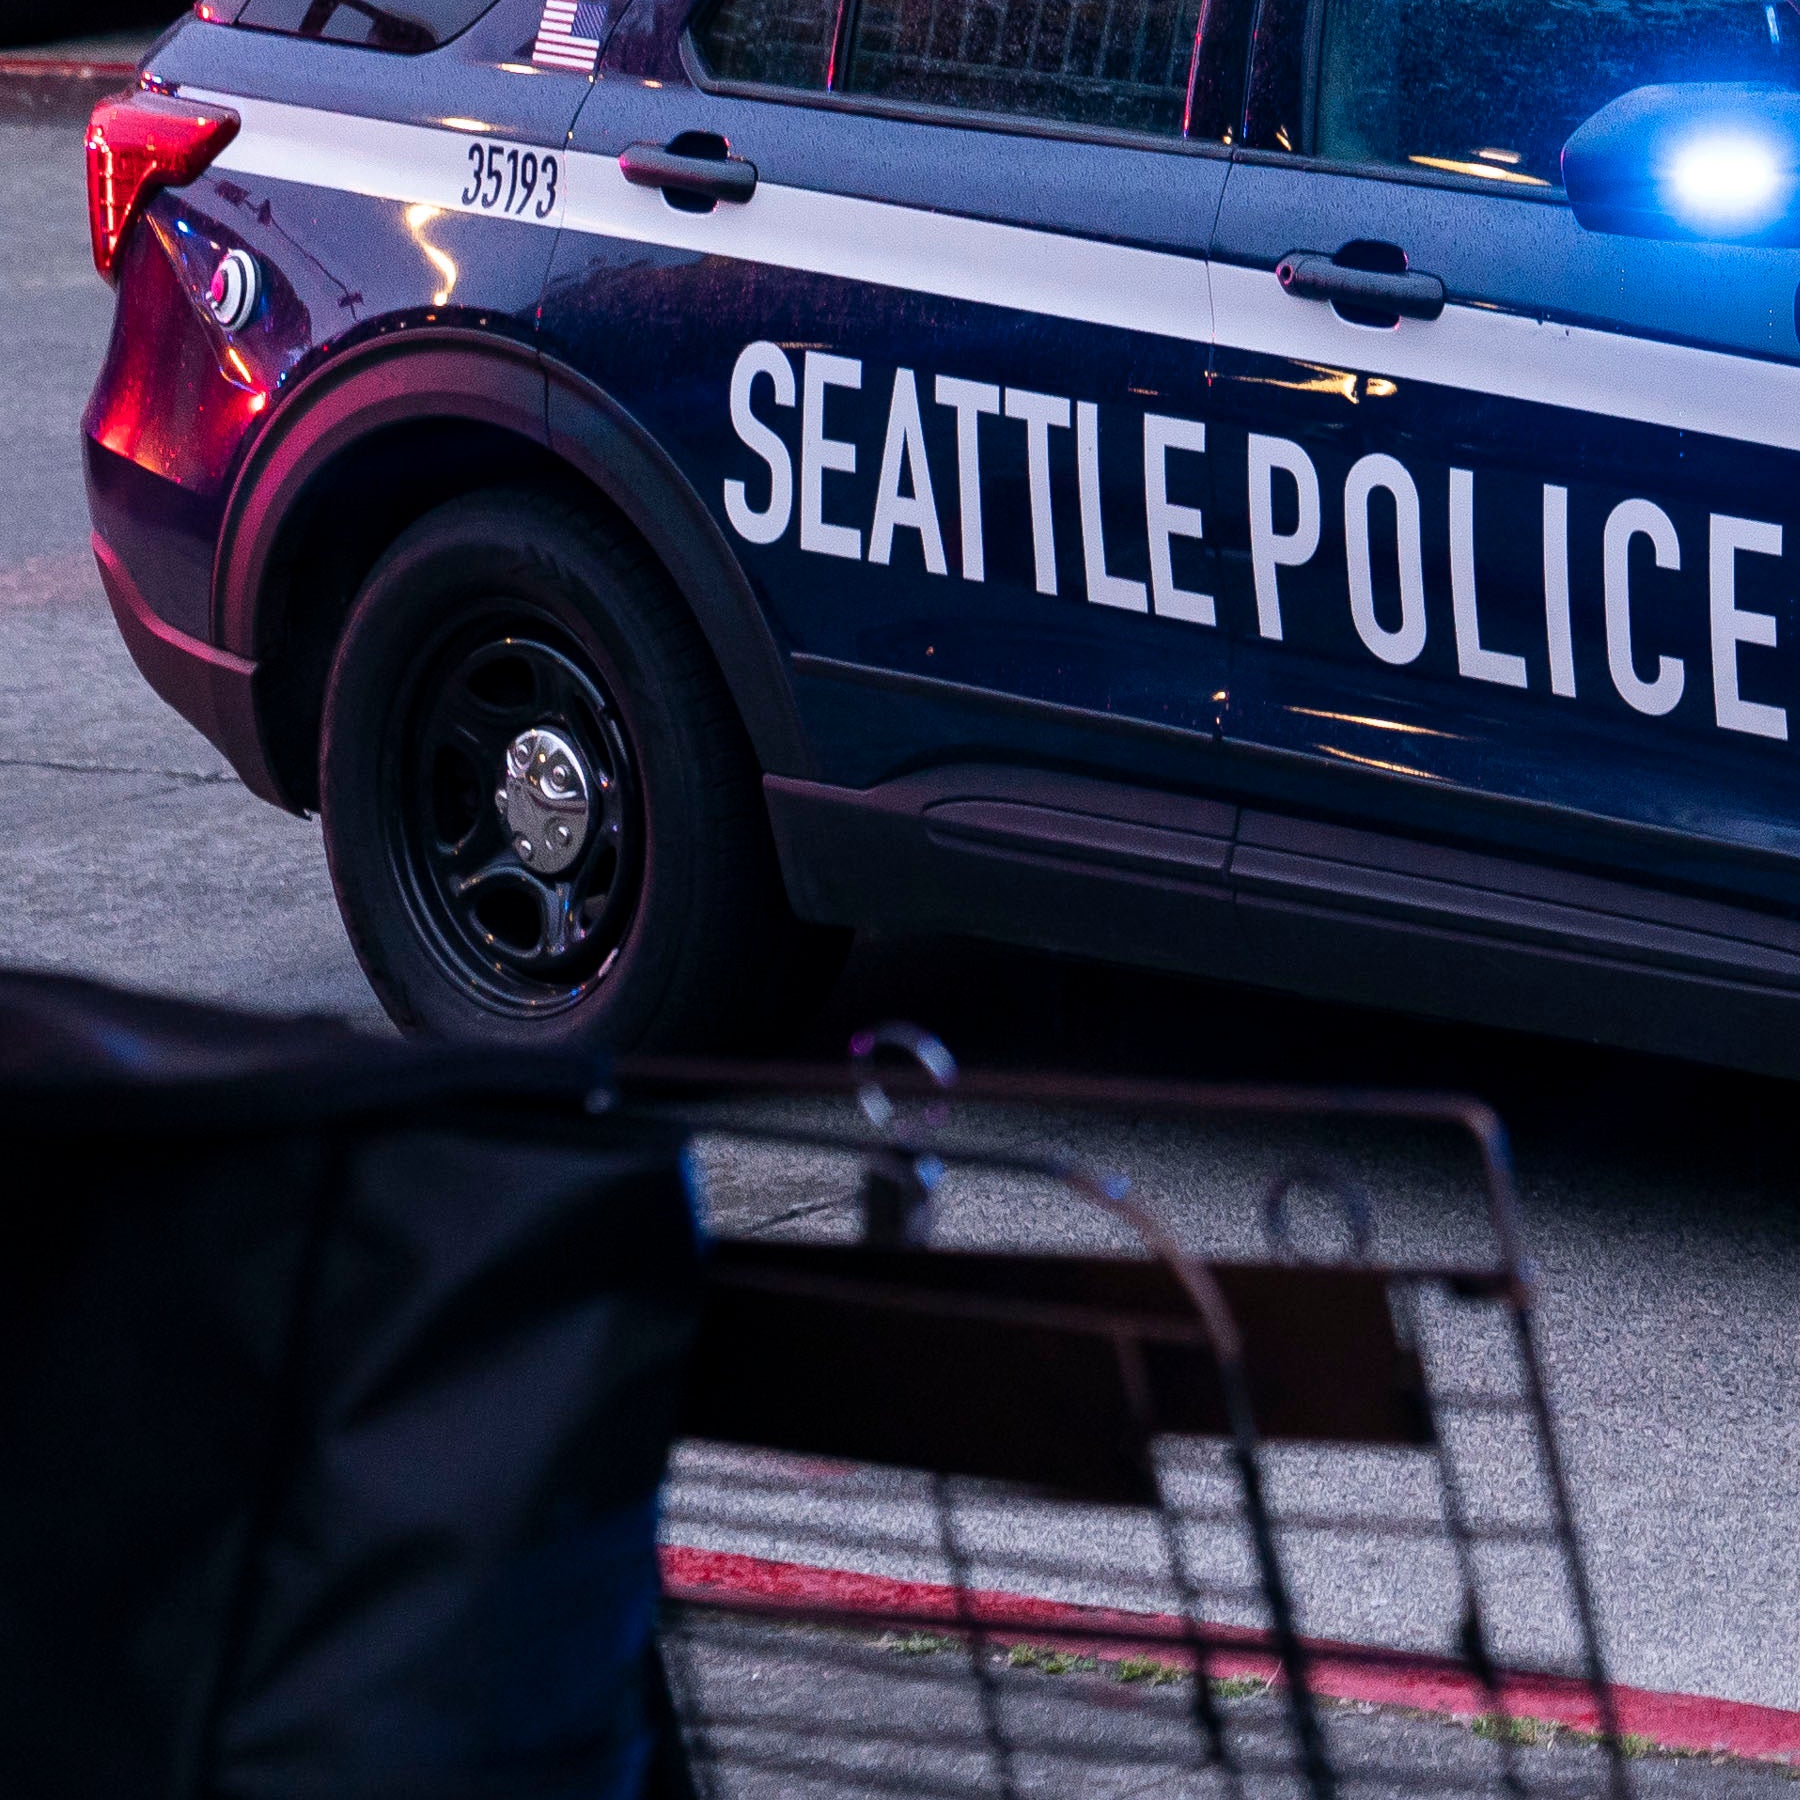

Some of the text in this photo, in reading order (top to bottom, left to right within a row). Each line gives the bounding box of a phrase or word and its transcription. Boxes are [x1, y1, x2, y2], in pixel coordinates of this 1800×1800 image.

[461, 142, 558, 219] 35193
[724, 341, 1789, 741] SEATTLE POLICE
